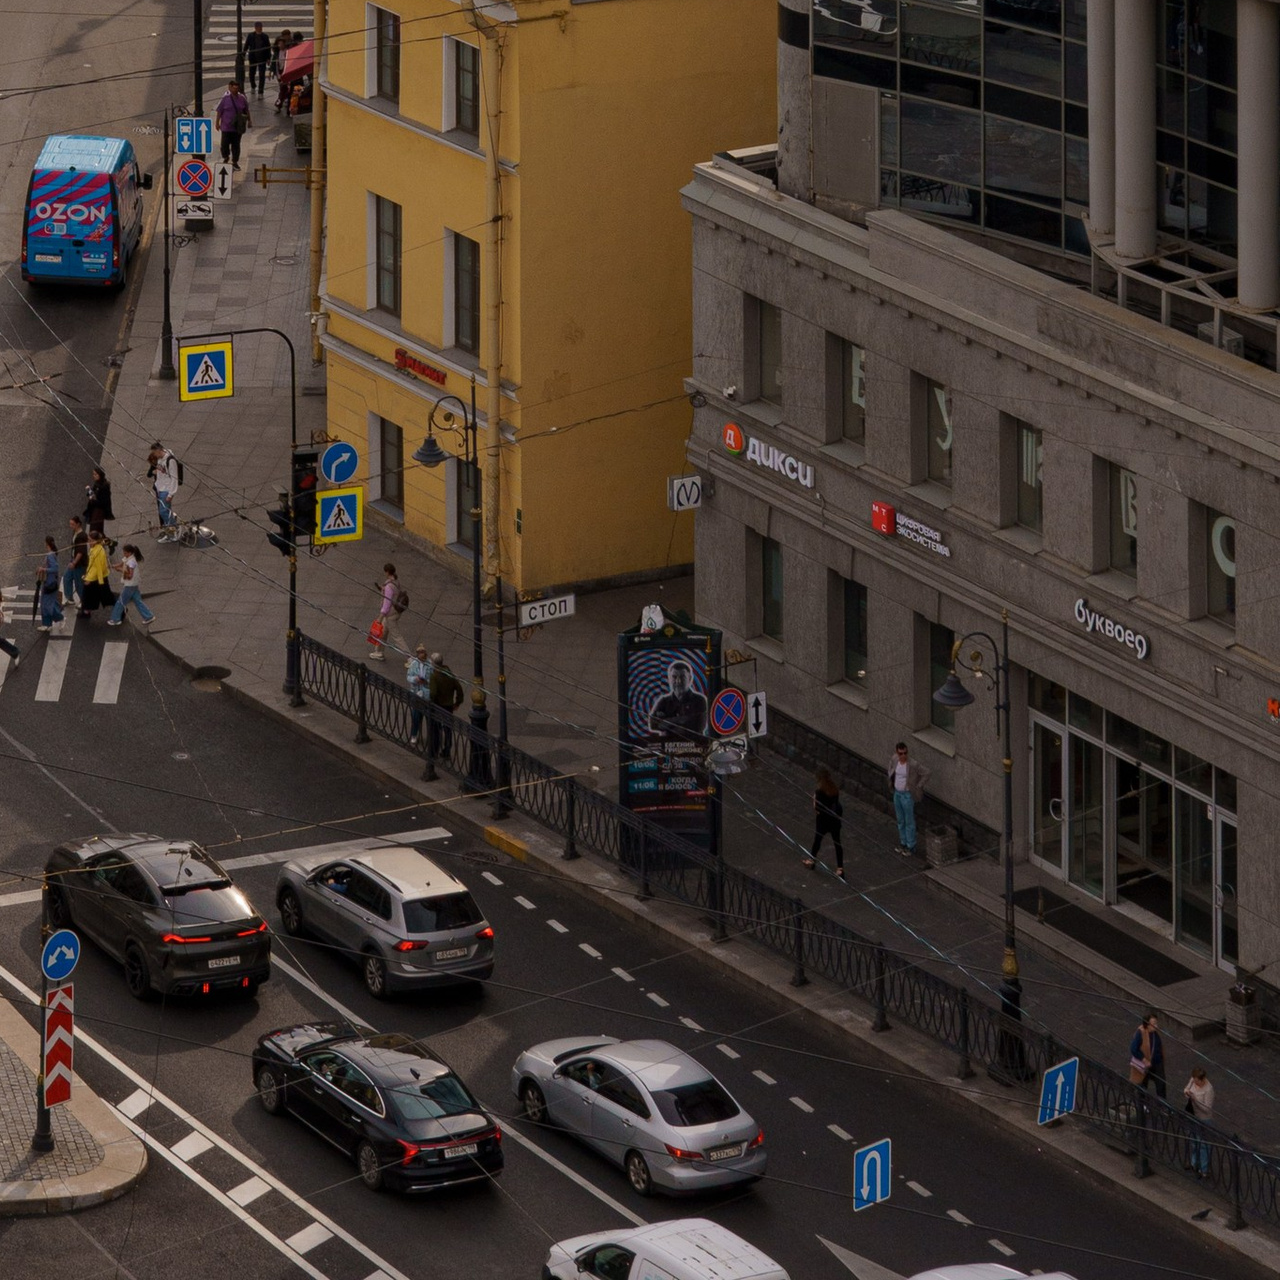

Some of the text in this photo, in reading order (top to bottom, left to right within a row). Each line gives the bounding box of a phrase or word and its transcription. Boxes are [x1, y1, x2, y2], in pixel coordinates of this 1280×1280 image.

[35, 202, 106, 222] OZON
[896, 512, 942, 542] ЦИФРОВАЯ
[896, 525, 951, 557] ЭКОСИСТЕМА
[528, 599, 567, 620] СТОП
